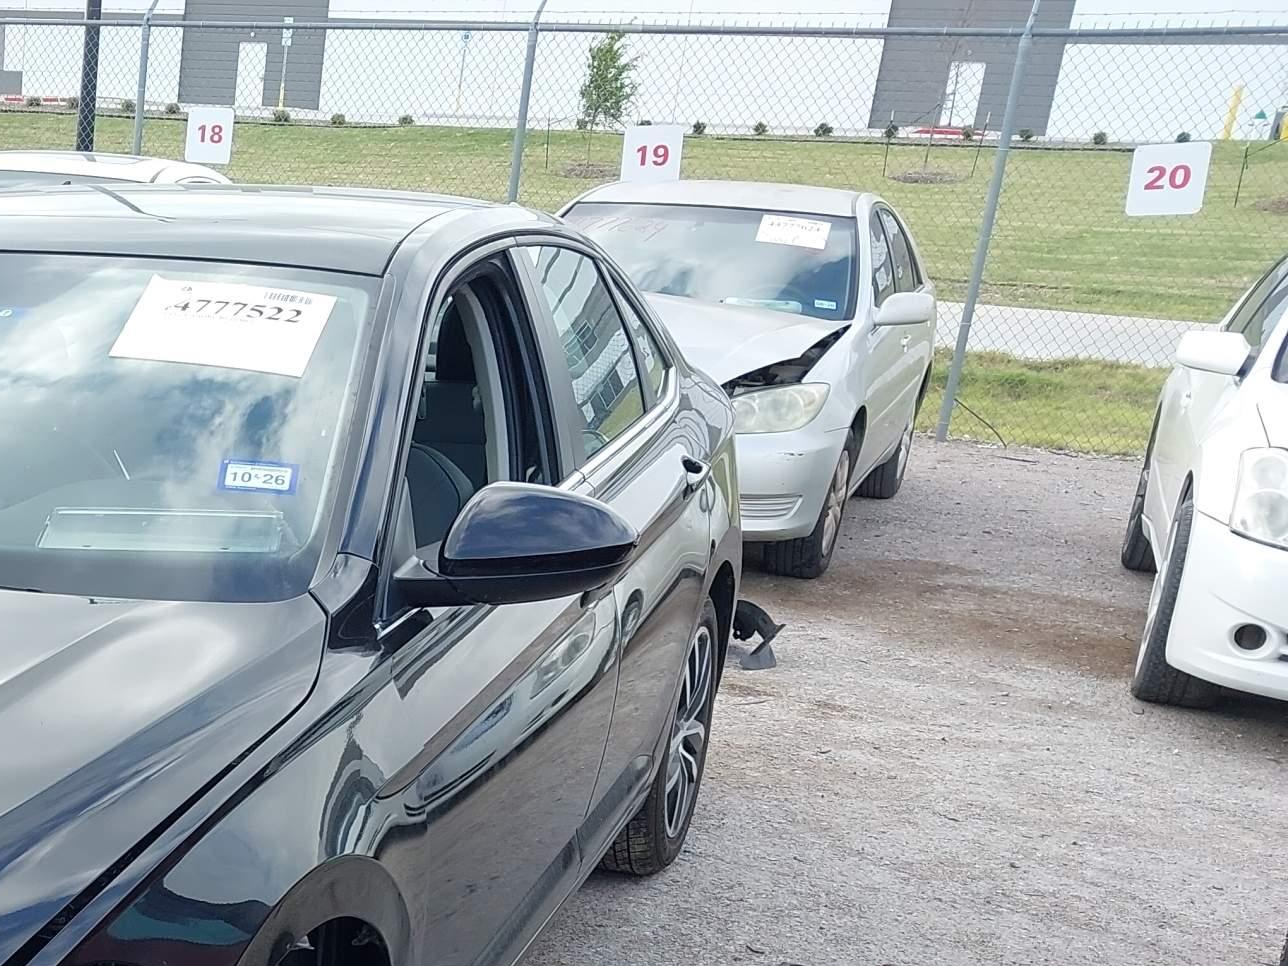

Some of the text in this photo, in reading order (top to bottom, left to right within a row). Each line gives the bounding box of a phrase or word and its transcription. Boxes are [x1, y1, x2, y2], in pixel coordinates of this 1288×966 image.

[197, 124, 223, 144] 18
[635, 144, 670, 167] 19
[1143, 164, 1192, 191] 20
[164, 299, 304, 324] 4777522
